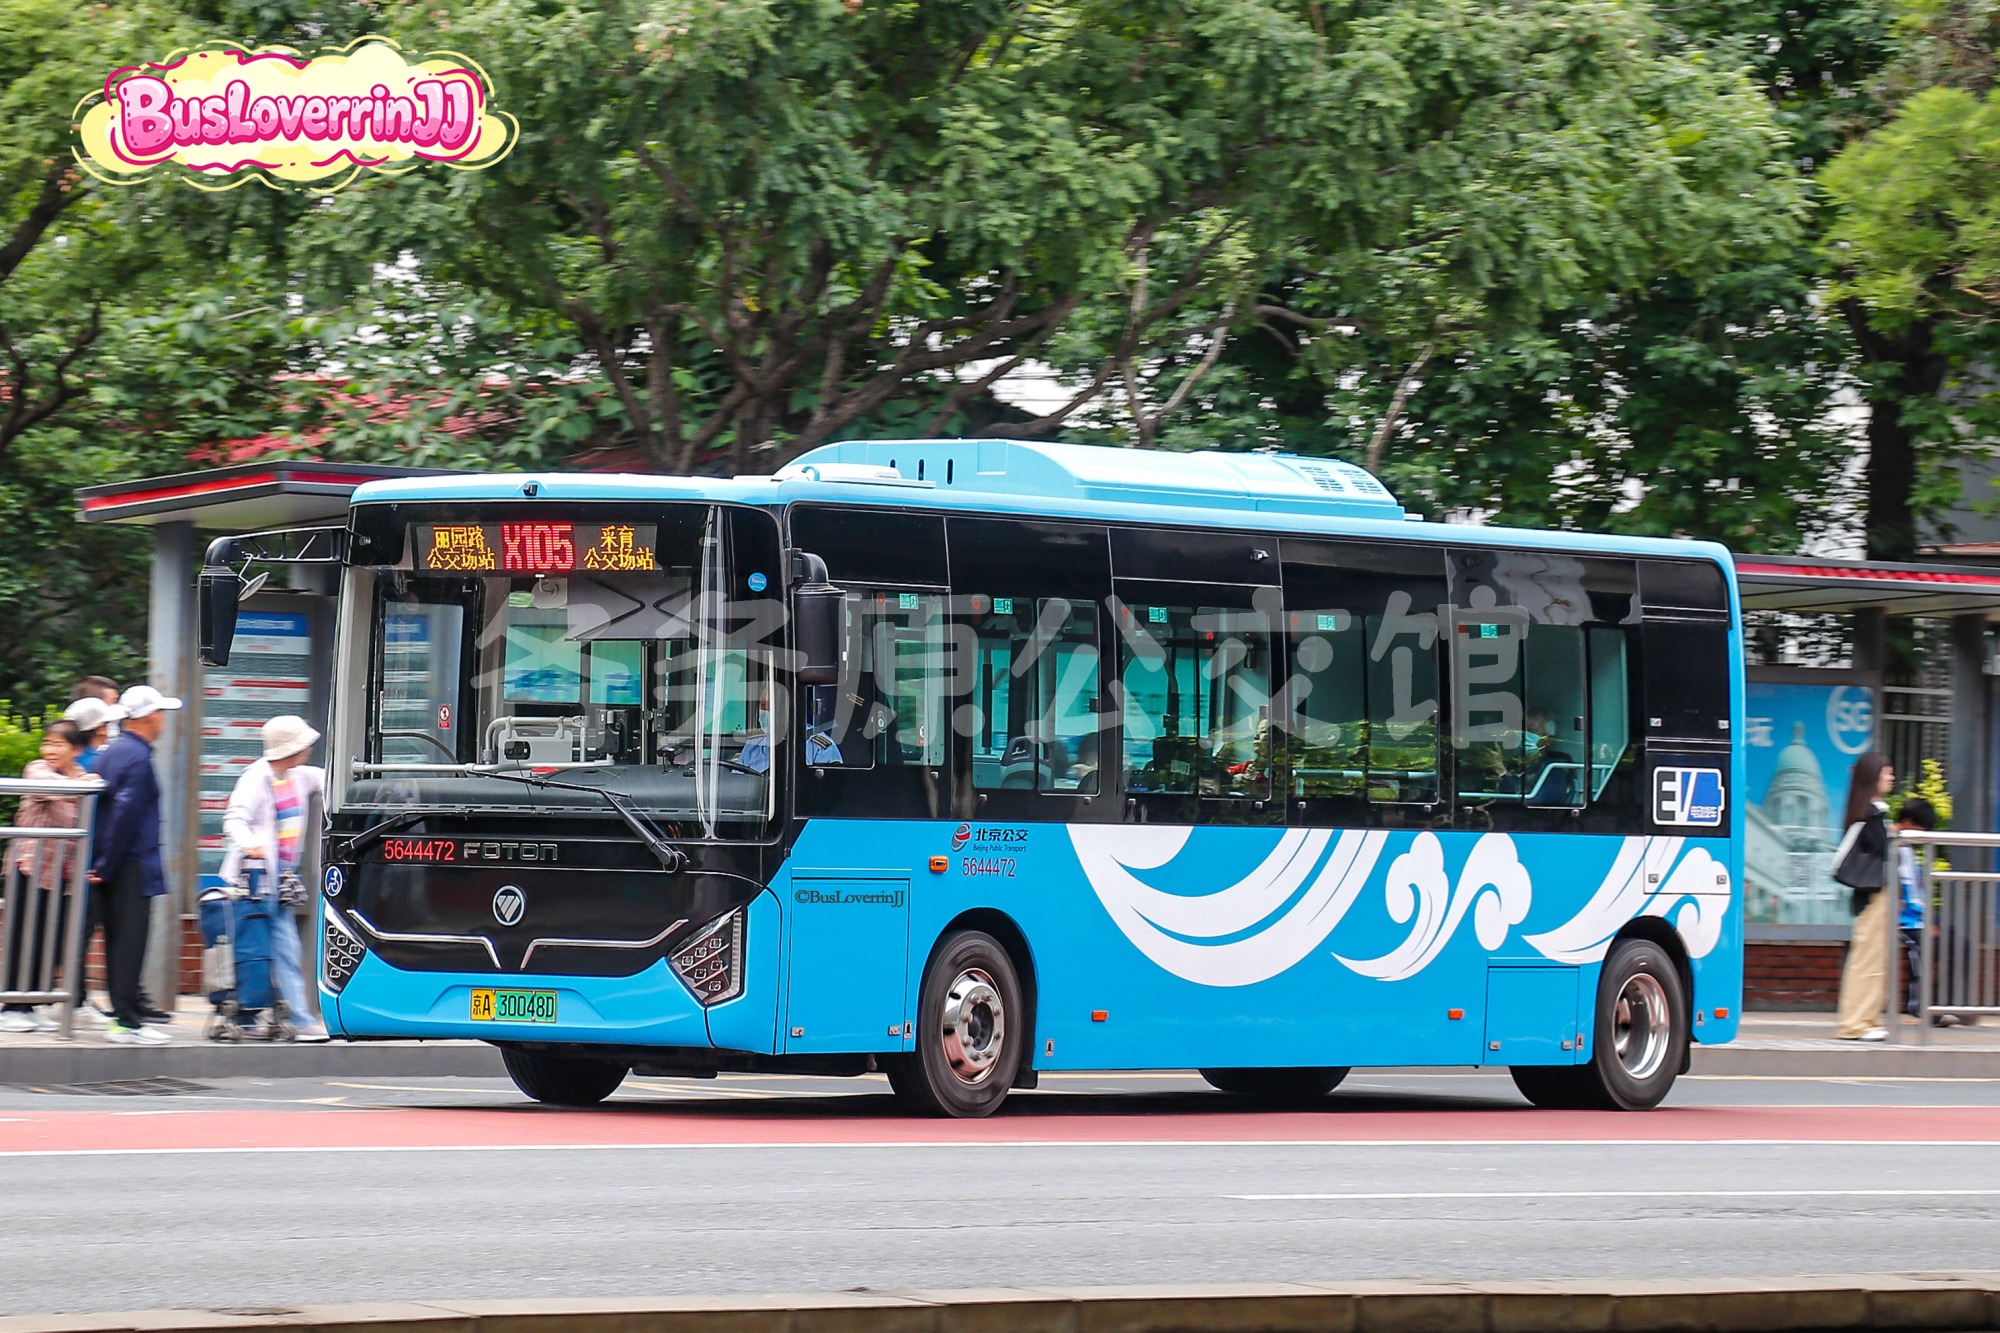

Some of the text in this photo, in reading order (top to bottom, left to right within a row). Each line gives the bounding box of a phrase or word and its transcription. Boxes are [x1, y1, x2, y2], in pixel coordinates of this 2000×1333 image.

[433, 525, 485, 549] 丽园路
[502, 523, 573, 571] X105
[600, 525, 635, 549] 采育
[426, 547, 495, 571] 公交场站
[584, 547, 654, 571] 公交场站
[975, 828, 1028, 842] 北京公交
[384, 840, 559, 861] 5644472 FOTON
[973, 844, 989, 852] Beijing
[1004, 844, 1026, 852] Transport
[962, 857, 1016, 877] 5644472
